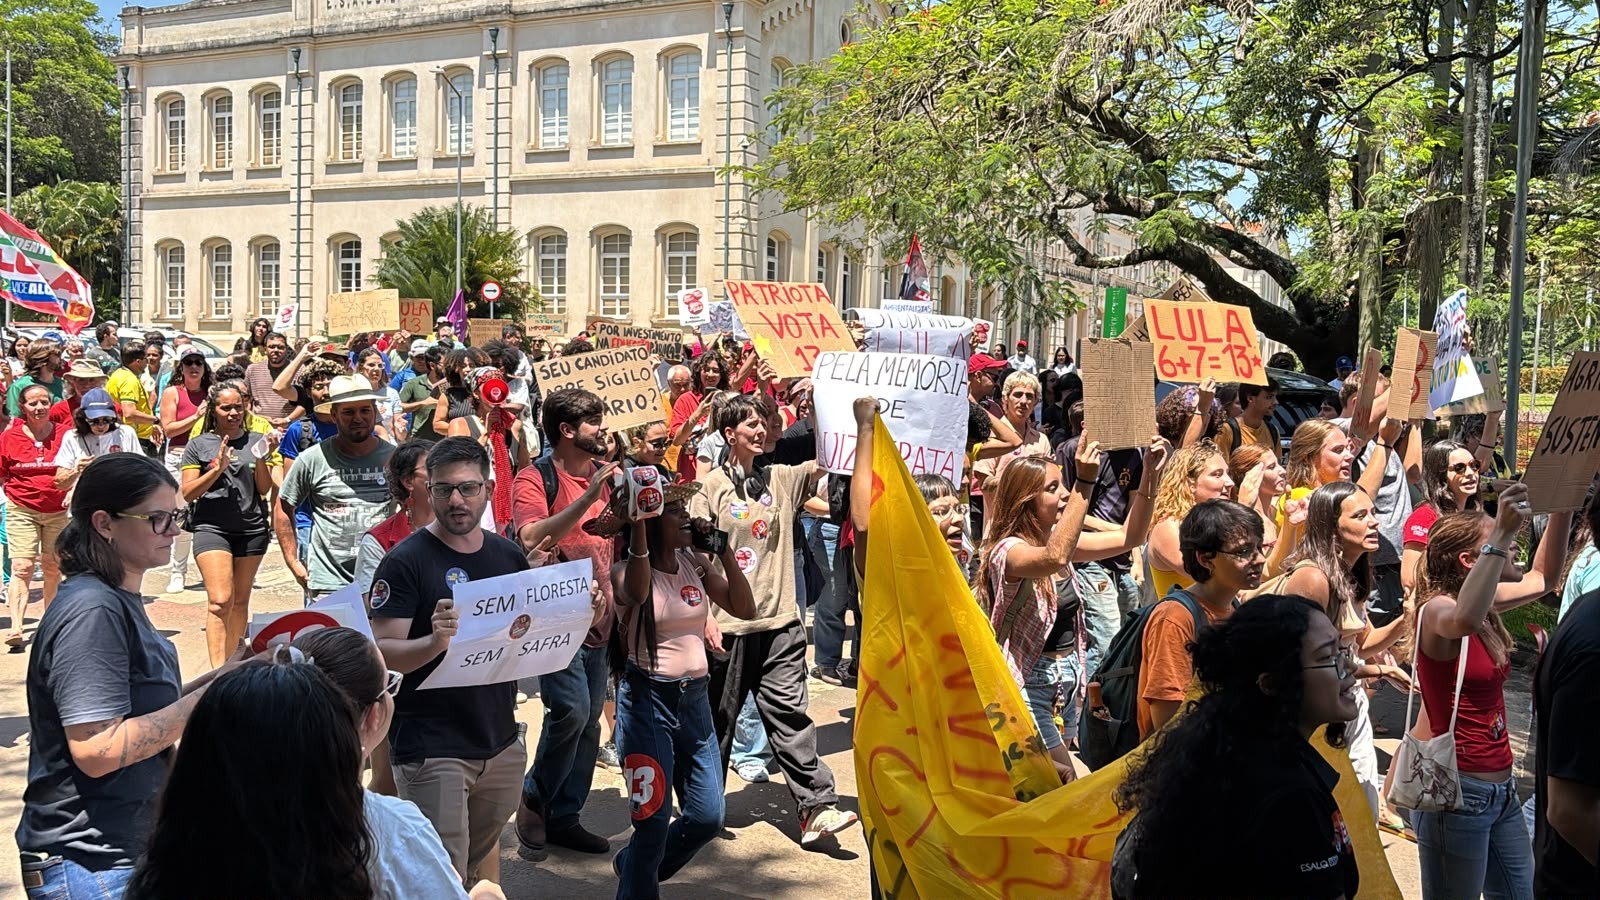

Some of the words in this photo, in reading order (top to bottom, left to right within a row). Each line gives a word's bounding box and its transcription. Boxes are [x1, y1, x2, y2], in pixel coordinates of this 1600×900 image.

[727, 281, 832, 305] PATRIOTA
[400, 302, 430, 316] ULA
[400, 317, 421, 333] 13
[600, 324, 620, 337] POR
[623, 327, 681, 342] INVESTIMENTO
[759, 312, 839, 339] VOTA
[1151, 305, 1252, 347] LULA
[596, 337, 610, 349] NA
[540, 361, 571, 380] SEU
[575, 347, 648, 370] CANDIDATO
[816, 352, 869, 386] PELA
[874, 356, 968, 396] MEMÓRIA
[1561, 359, 1600, 392] AGRI
[594, 367, 651, 390] SIGILO
[602, 388, 658, 416] ÁRIO?
[473, 594, 515, 616] SEM
[526, 577, 589, 605] FLORESTA
[460, 647, 504, 668] SEM
[518, 633, 571, 657] SAFRA
